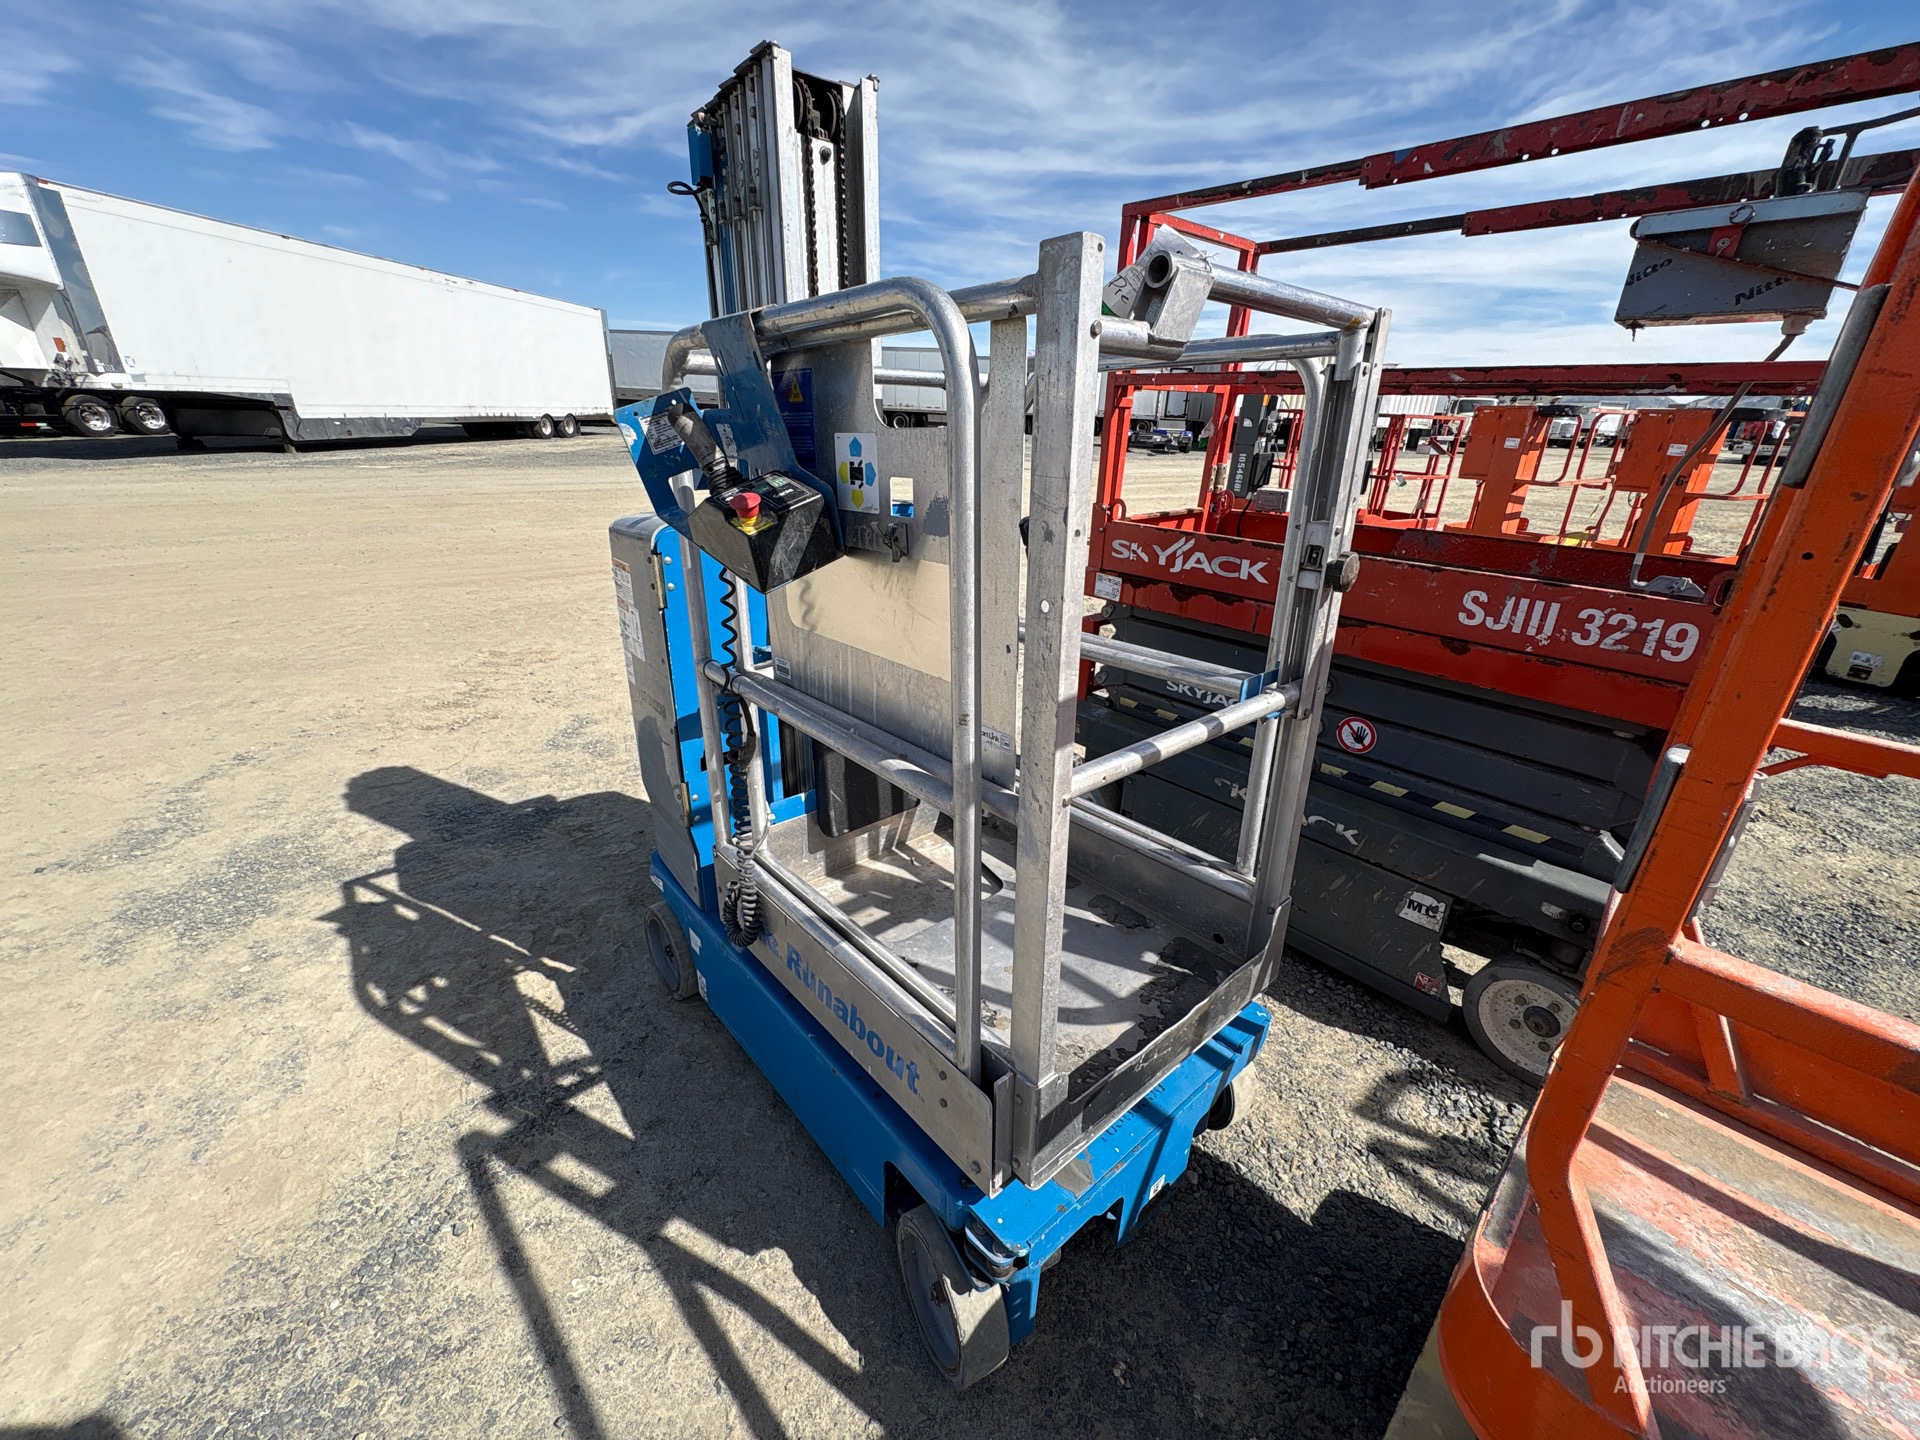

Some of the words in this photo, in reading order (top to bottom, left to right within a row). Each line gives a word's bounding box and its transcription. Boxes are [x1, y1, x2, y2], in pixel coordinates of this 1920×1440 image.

[1111, 536, 1269, 584] SKYJACK
[1571, 608, 1700, 662] 3219
[1166, 681, 1241, 707] SKYJAC
[786, 943, 920, 1096] Runabout
